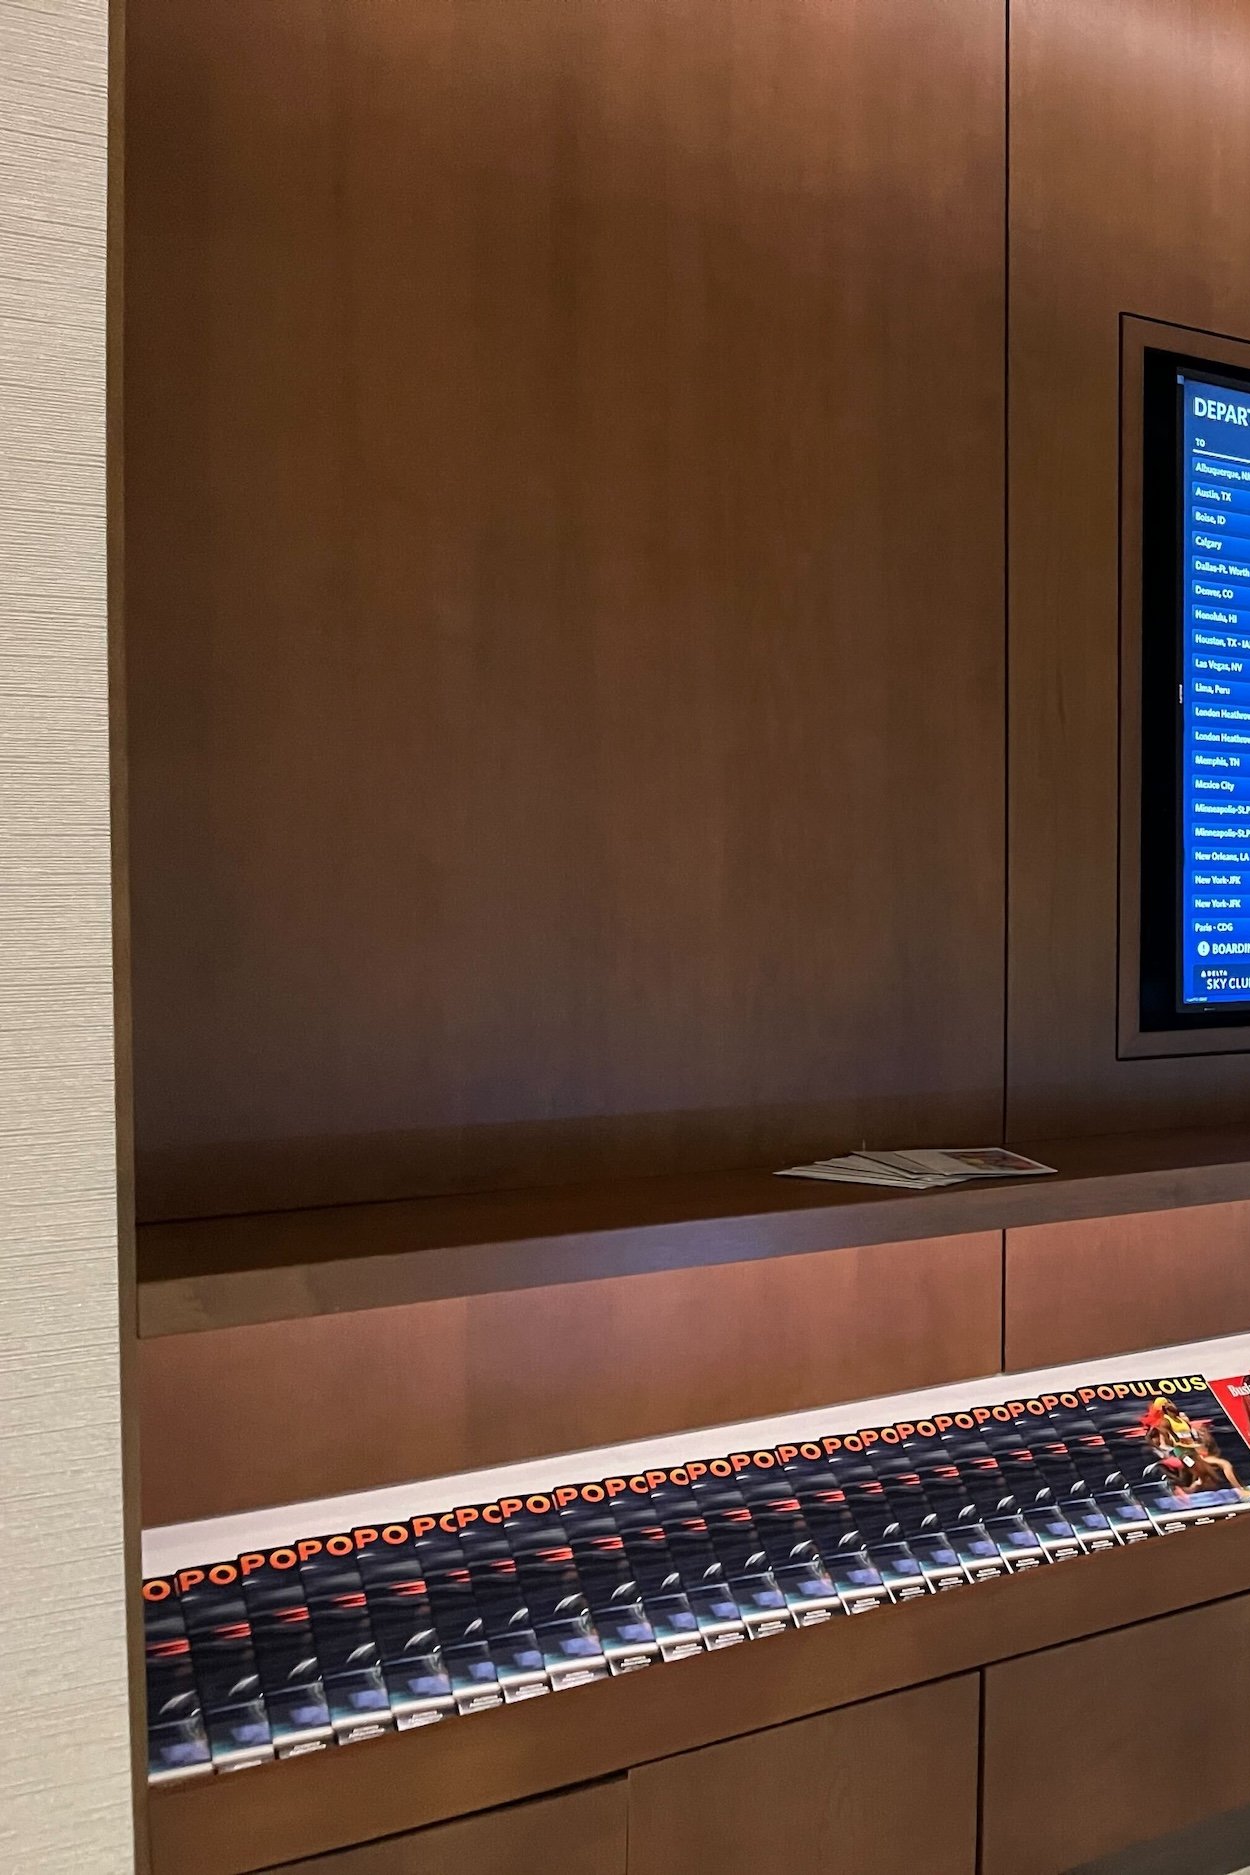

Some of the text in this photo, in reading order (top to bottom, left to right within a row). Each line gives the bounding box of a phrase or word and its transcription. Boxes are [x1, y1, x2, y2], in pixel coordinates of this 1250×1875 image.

[1195, 438, 1205, 447] TO
[1196, 463, 1241, 480] Albuquerque,
[1196, 487, 1231, 502] Austin, TX
[1195, 511, 1226, 525] Boise, ID
[1195, 536, 1222, 550] Calgary
[1229, 566, 1250, 577] Worth
[1195, 585, 1234, 599] Denver, CO
[1195, 610, 1228, 623] Honolulu,
[1195, 634, 1226, 647] Houston,
[1227, 638, 1237, 647] TX
[1195, 659, 1242, 672] Las Vegas, NV
[1195, 683, 1230, 694] Lima, Peru
[1195, 707, 1220, 717] London
[1195, 731, 1220, 741] London
[1195, 755, 1228, 767] Memphis,
[1195, 780, 1235, 792] Mexico City
[1195, 852, 1250, 862] New Orleans, LA
[1195, 875, 1211, 884] New
[1195, 899, 1211, 908] New
[1195, 923, 1233, 932] Paris CDG
[1207, 978, 1227, 990] SKY
[1078, 1376, 1208, 1404] POPULOUS
